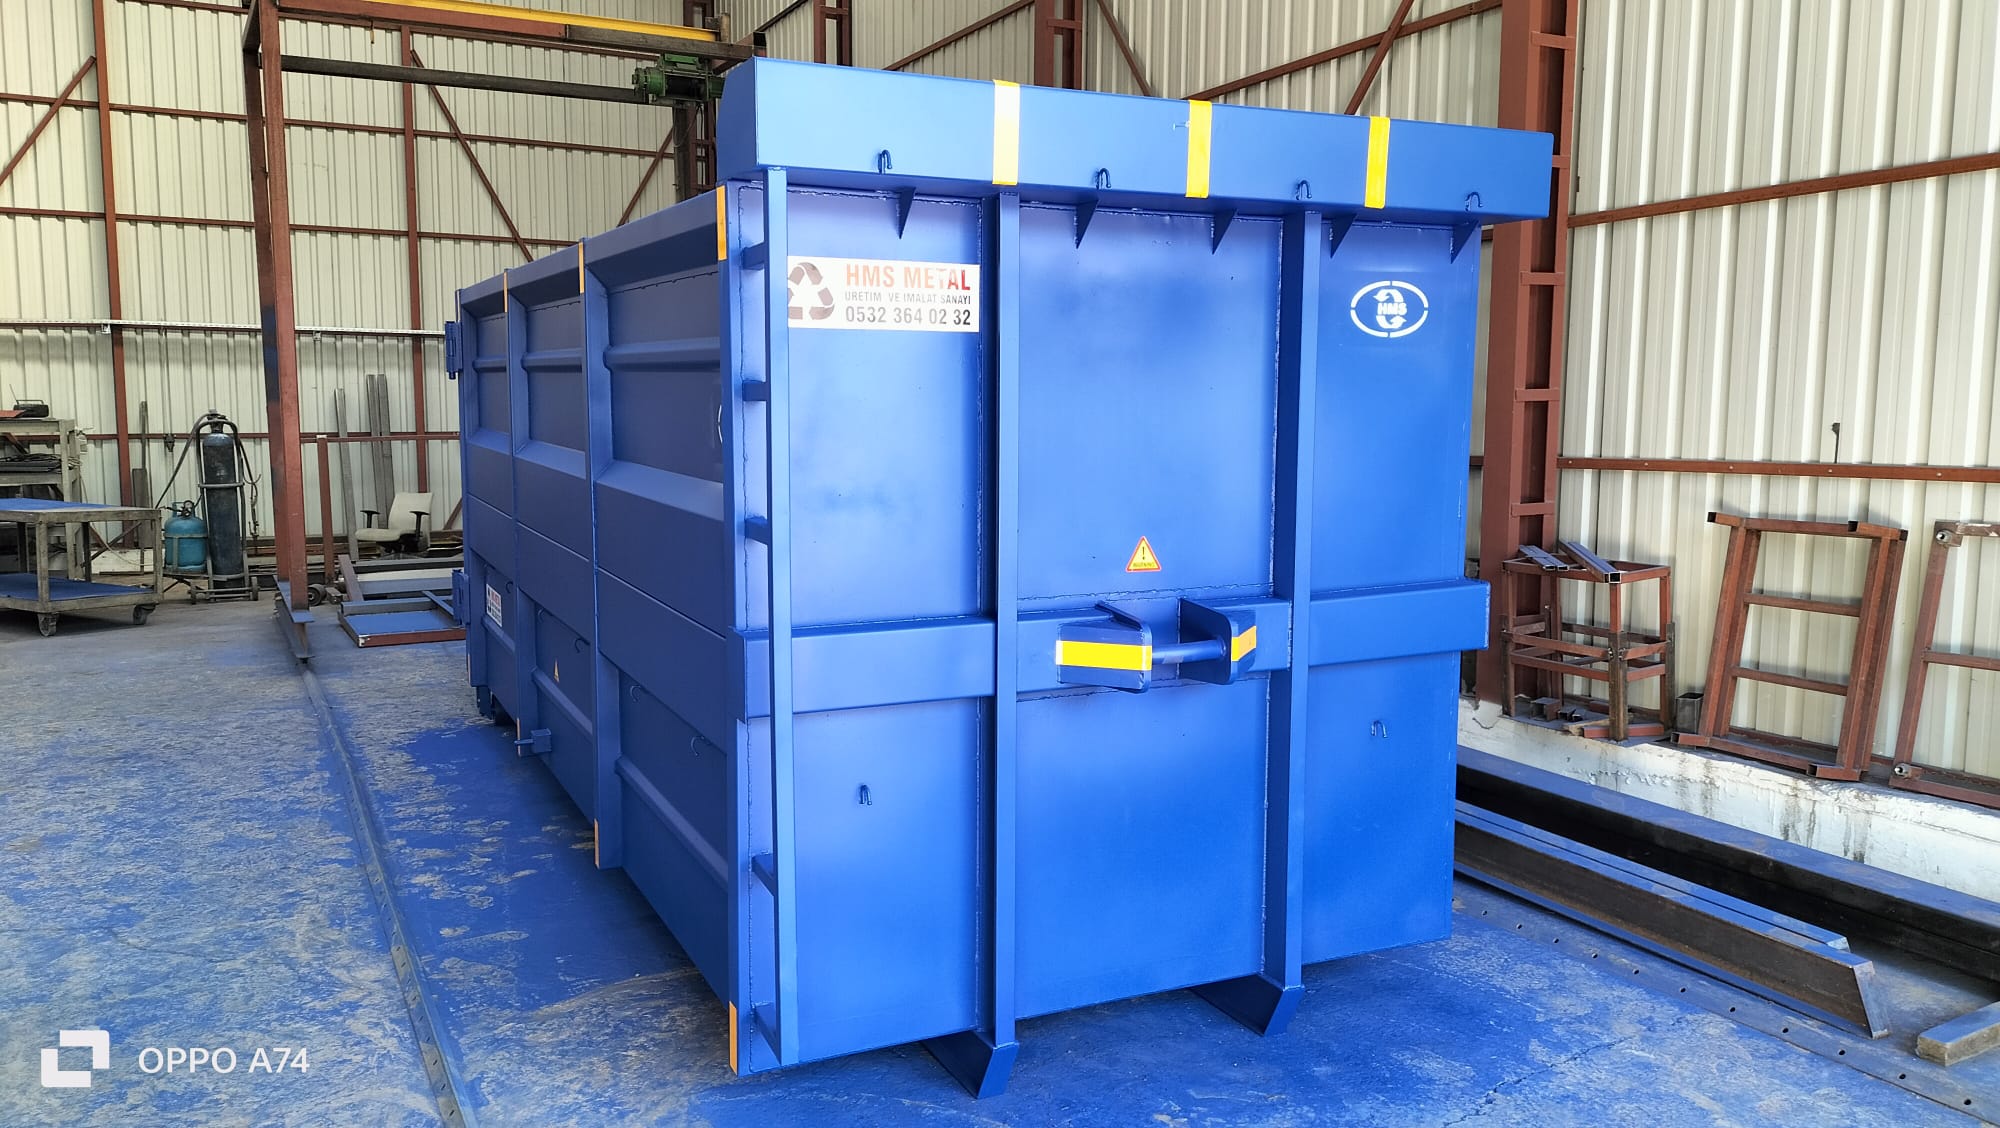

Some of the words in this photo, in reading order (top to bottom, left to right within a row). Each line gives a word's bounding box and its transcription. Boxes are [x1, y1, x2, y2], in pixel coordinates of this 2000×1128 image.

[846, 264, 895, 288] HMS
[904, 266, 971, 291] METAL
[888, 292, 900, 303] VE
[846, 305, 887, 324] 0532
[893, 307, 923, 325] 364
[929, 308, 948, 325] 02
[953, 309, 971, 326] 32
[1377, 302, 1408, 316] HMS
